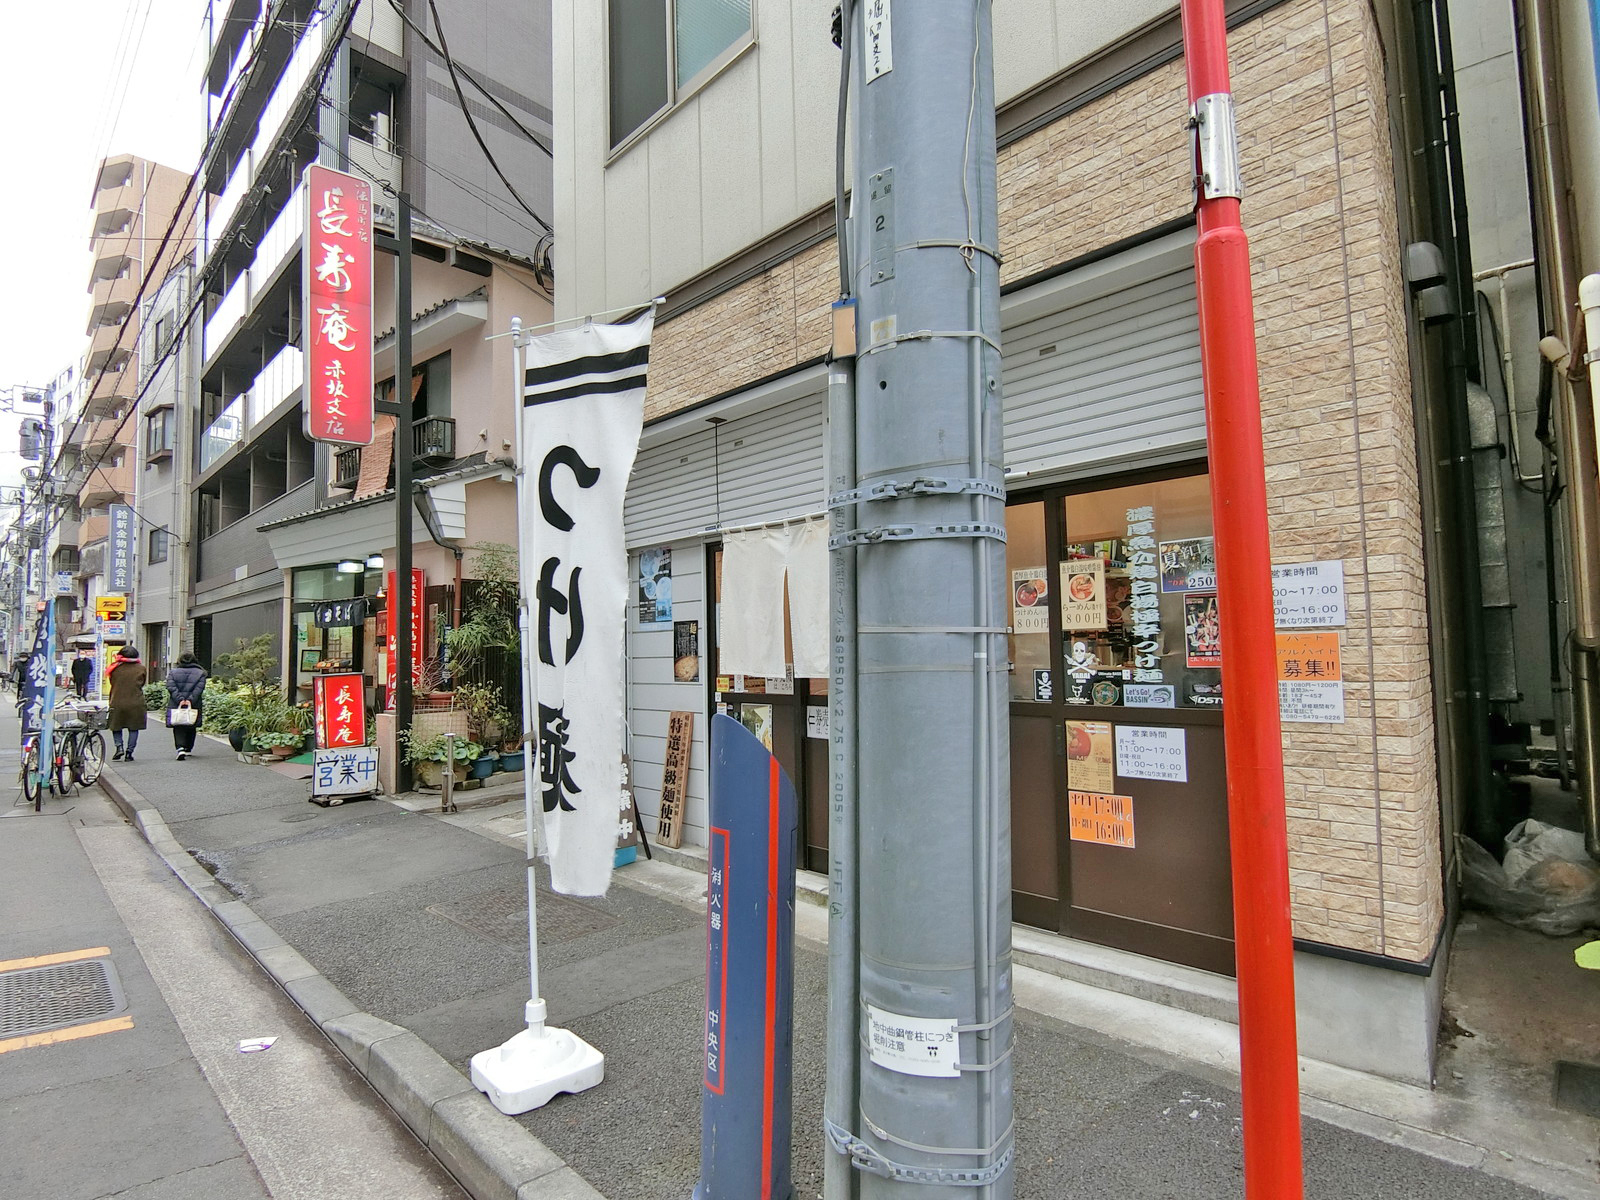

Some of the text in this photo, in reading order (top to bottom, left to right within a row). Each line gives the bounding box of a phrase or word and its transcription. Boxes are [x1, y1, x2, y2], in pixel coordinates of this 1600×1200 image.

[875, 214, 886, 232] 2
[315, 187, 359, 352] 長寿庵
[325, 359, 349, 436] 赤坂支店
[115, 509, 129, 588] 鈴新金物有限会社
[1271, 567, 1318, 578] 営業時間
[1014, 608, 1039, 616] つけめん
[1062, 603, 1091, 612] らーめん
[1066, 613, 1102, 624] 800円
[1283, 659, 1335, 678] 募集!!
[334, 685, 358, 743] 長寿庵
[1131, 730, 1167, 739] 営業時間
[317, 754, 376, 788] 営業中
[657, 717, 683, 839] 特選高級麺使用
[833, 854, 843, 894] JFE
[710, 866, 722, 931] 消火器
[707, 1009, 719, 1073] 中央区
